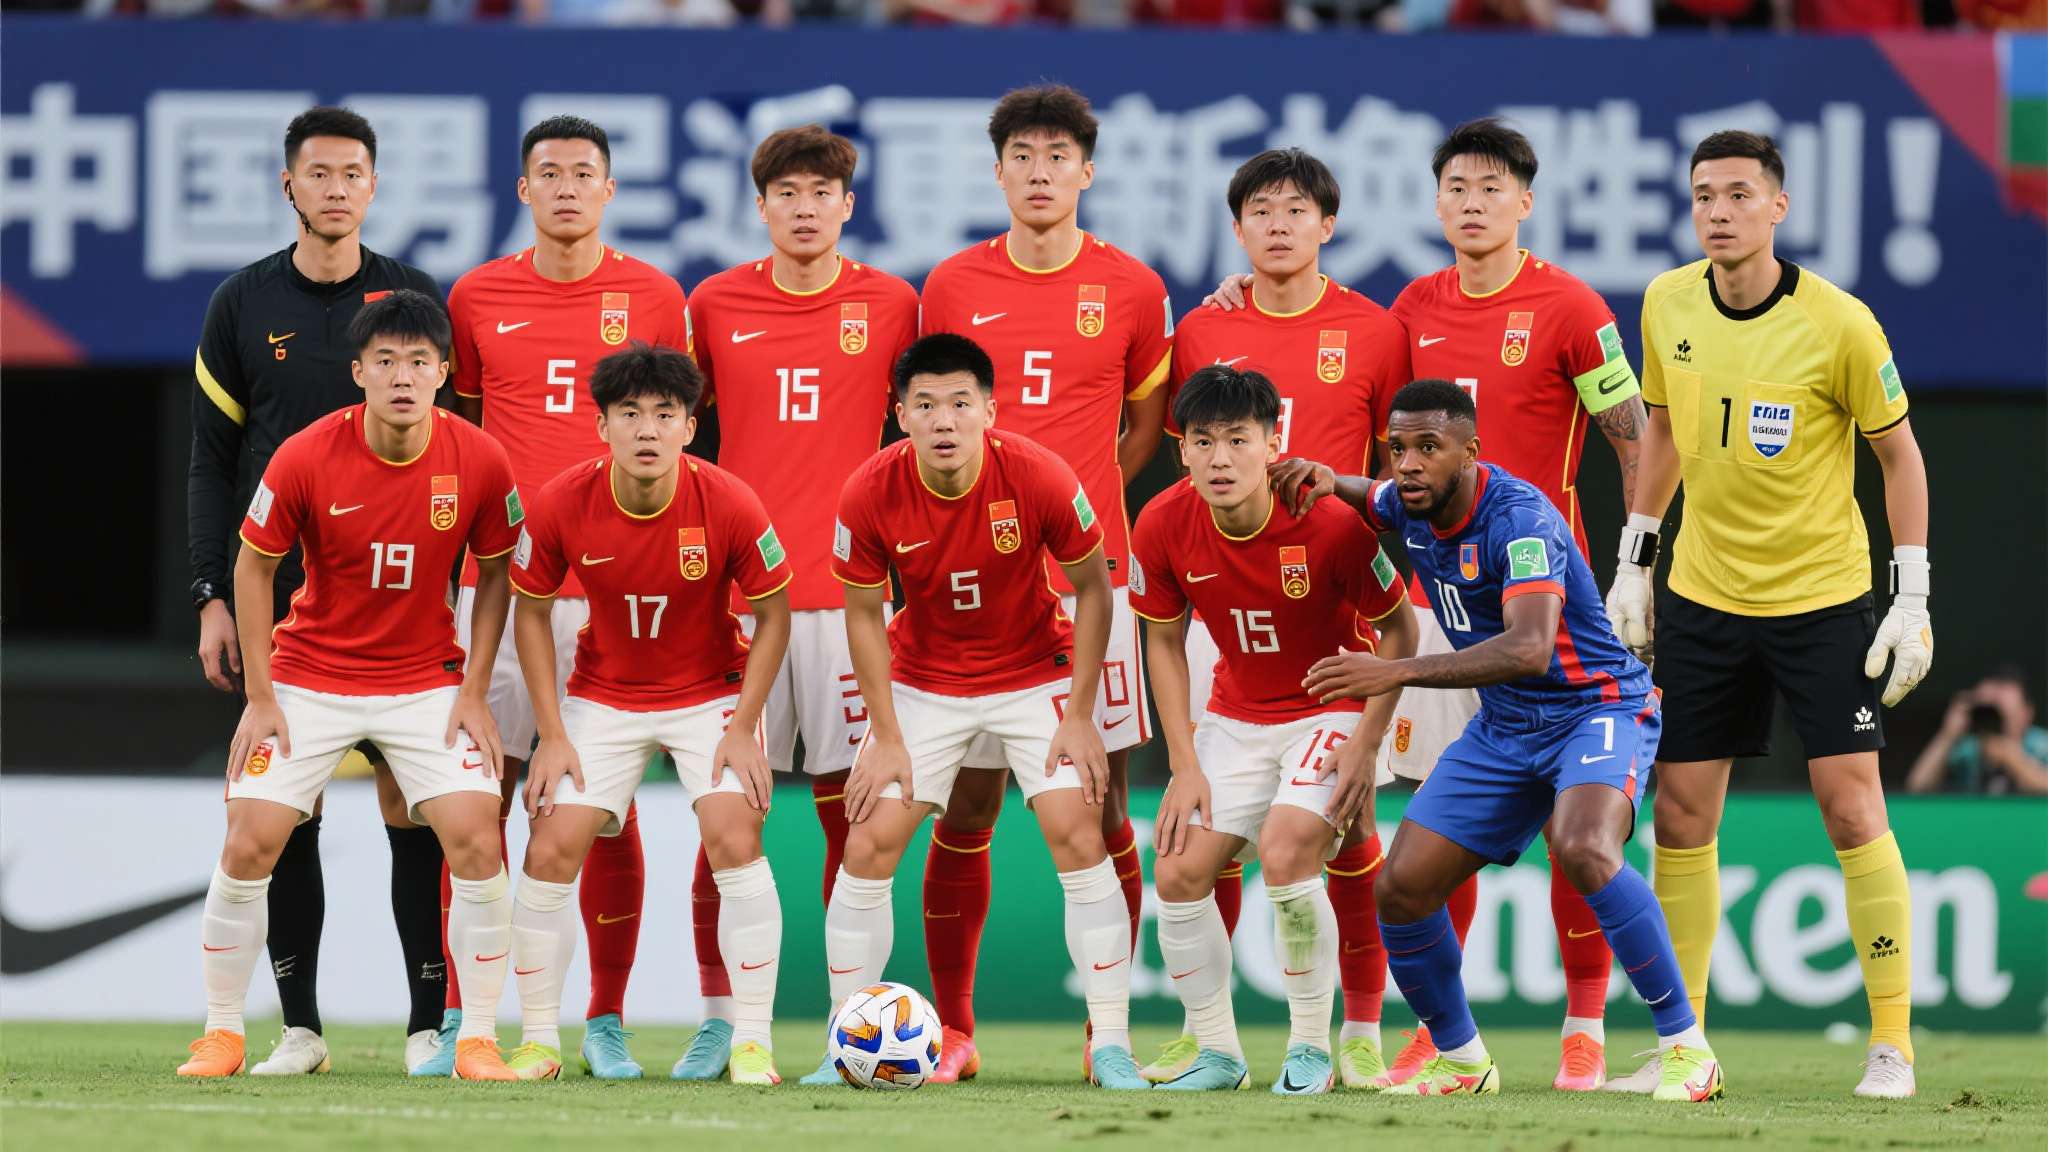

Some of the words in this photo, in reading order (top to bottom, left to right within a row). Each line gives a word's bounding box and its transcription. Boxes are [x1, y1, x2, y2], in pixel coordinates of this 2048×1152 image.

[545, 359, 577, 414] 5
[775, 367, 821, 422] 15
[1022, 350, 1053, 405] 5
[1721, 397, 1732, 448] 1
[370, 542, 415, 590] 19
[950, 569, 982, 611] 5
[624, 594, 668, 639] 17
[1434, 577, 1472, 633] 10
[1229, 608, 1281, 654] 15
[1590, 716, 1615, 752] 7
